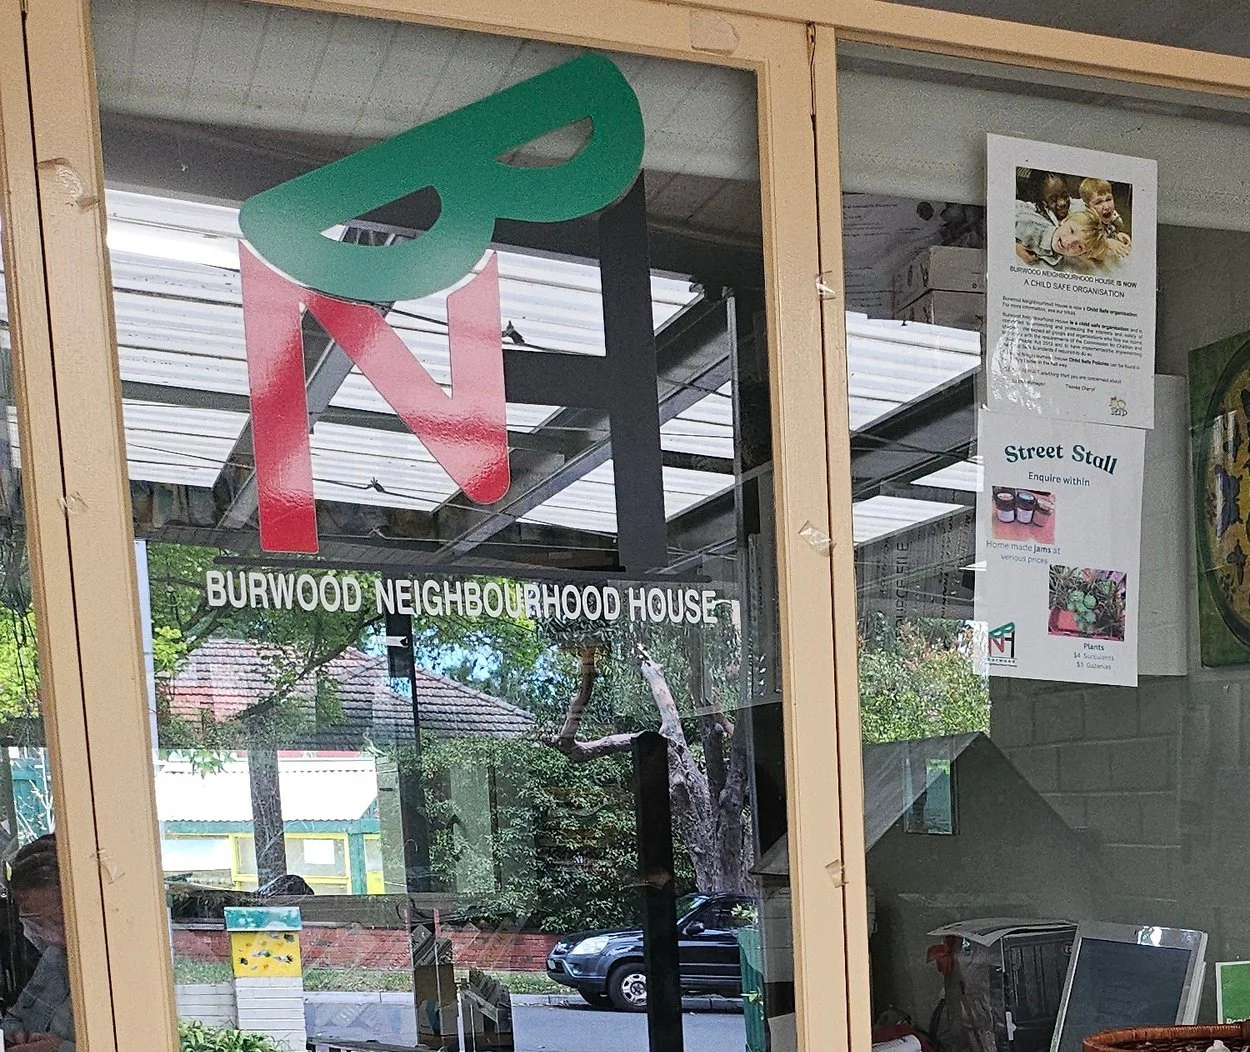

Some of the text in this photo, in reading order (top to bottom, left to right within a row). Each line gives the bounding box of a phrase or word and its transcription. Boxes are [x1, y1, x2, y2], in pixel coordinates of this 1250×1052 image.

[1010, 266, 1041, 276] BURWOOD
[1042, 270, 1094, 283] NEIGHBOURHOOD
[1095, 277, 1115, 286] HOUSE
[1031, 280, 1051, 288] CHILD
[1053, 283, 1071, 291] SAFE
[1073, 285, 1125, 298] ORGANISATION
[1004, 444, 1118, 475] Street Stall
[1028, 471, 1090, 487] Enquire within
[986, 541, 1009, 549] Home
[1011, 544, 1032, 552] made
[206, 569, 718, 625] BURWOOD NEIGHBOURHOOD HOUSE
[1084, 642, 1105, 651] Plants
